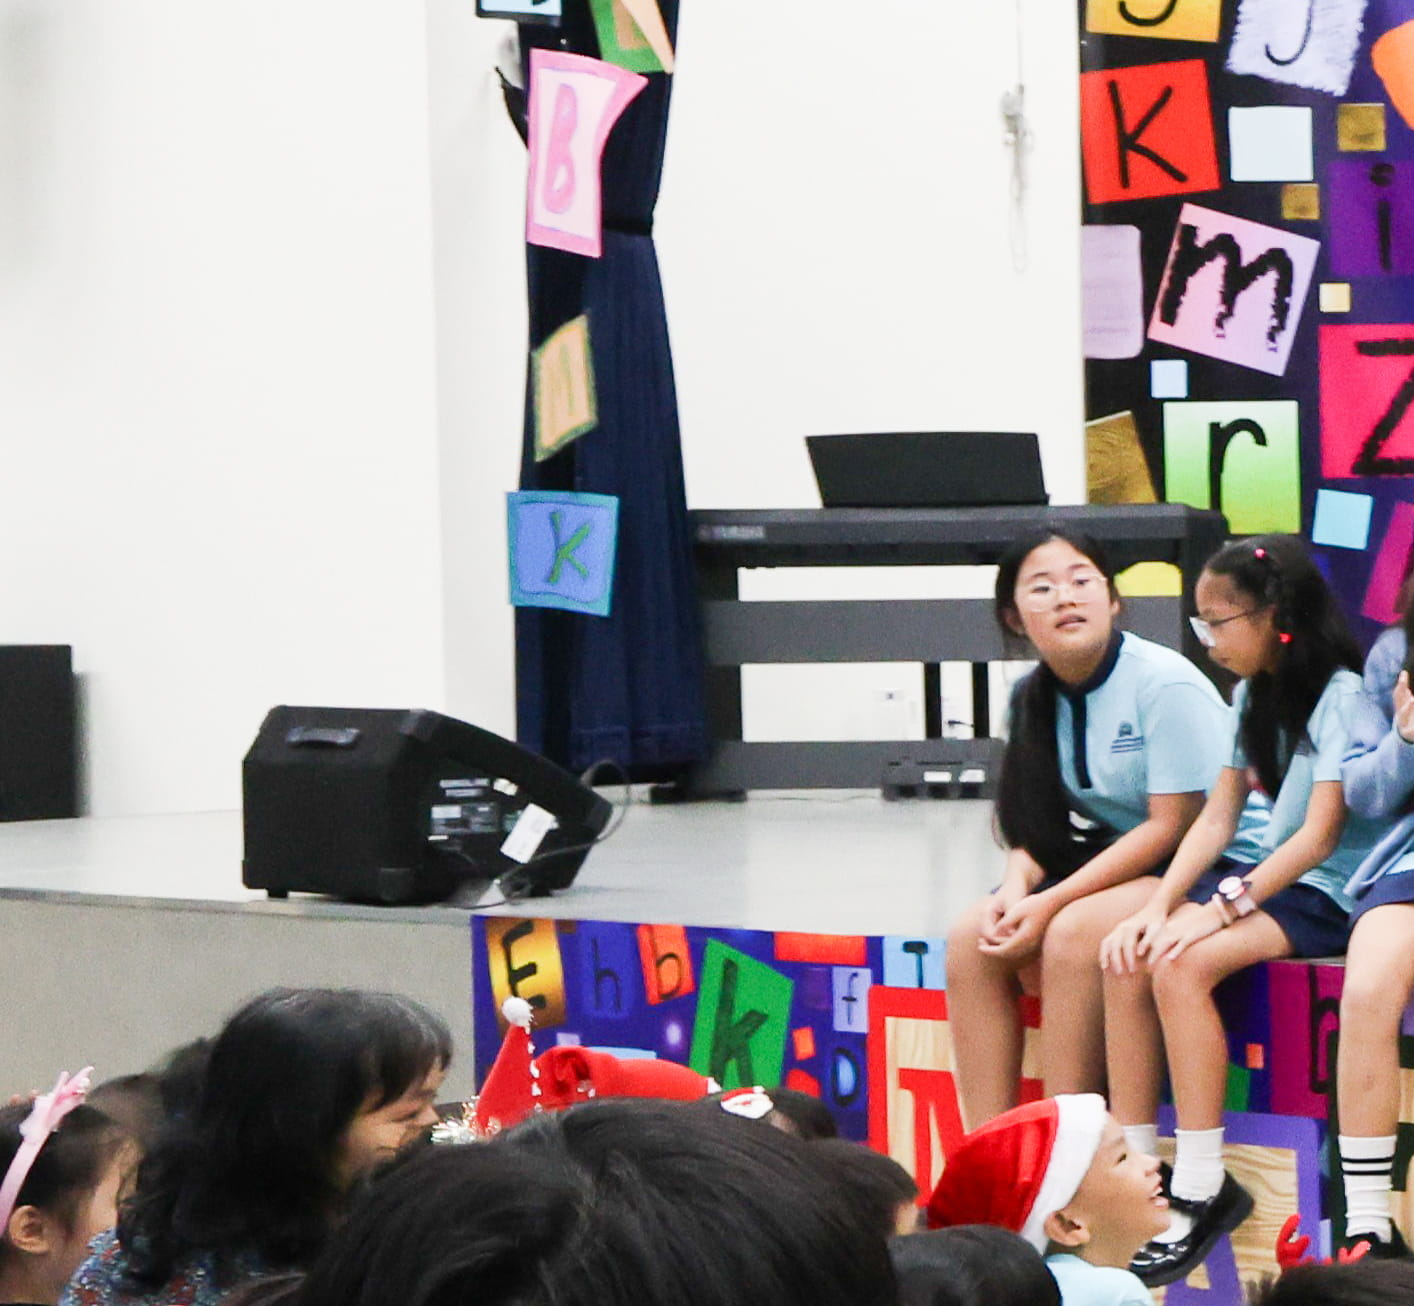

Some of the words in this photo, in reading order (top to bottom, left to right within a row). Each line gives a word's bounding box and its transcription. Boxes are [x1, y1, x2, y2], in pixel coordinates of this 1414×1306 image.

[543, 82, 579, 214] B
[1369, 162, 1395, 272] i
[1161, 223, 1294, 354] m
[1209, 419, 1267, 533] r
[545, 511, 592, 584] K
[649, 923, 684, 1001] b
[842, 972, 859, 1025] f
